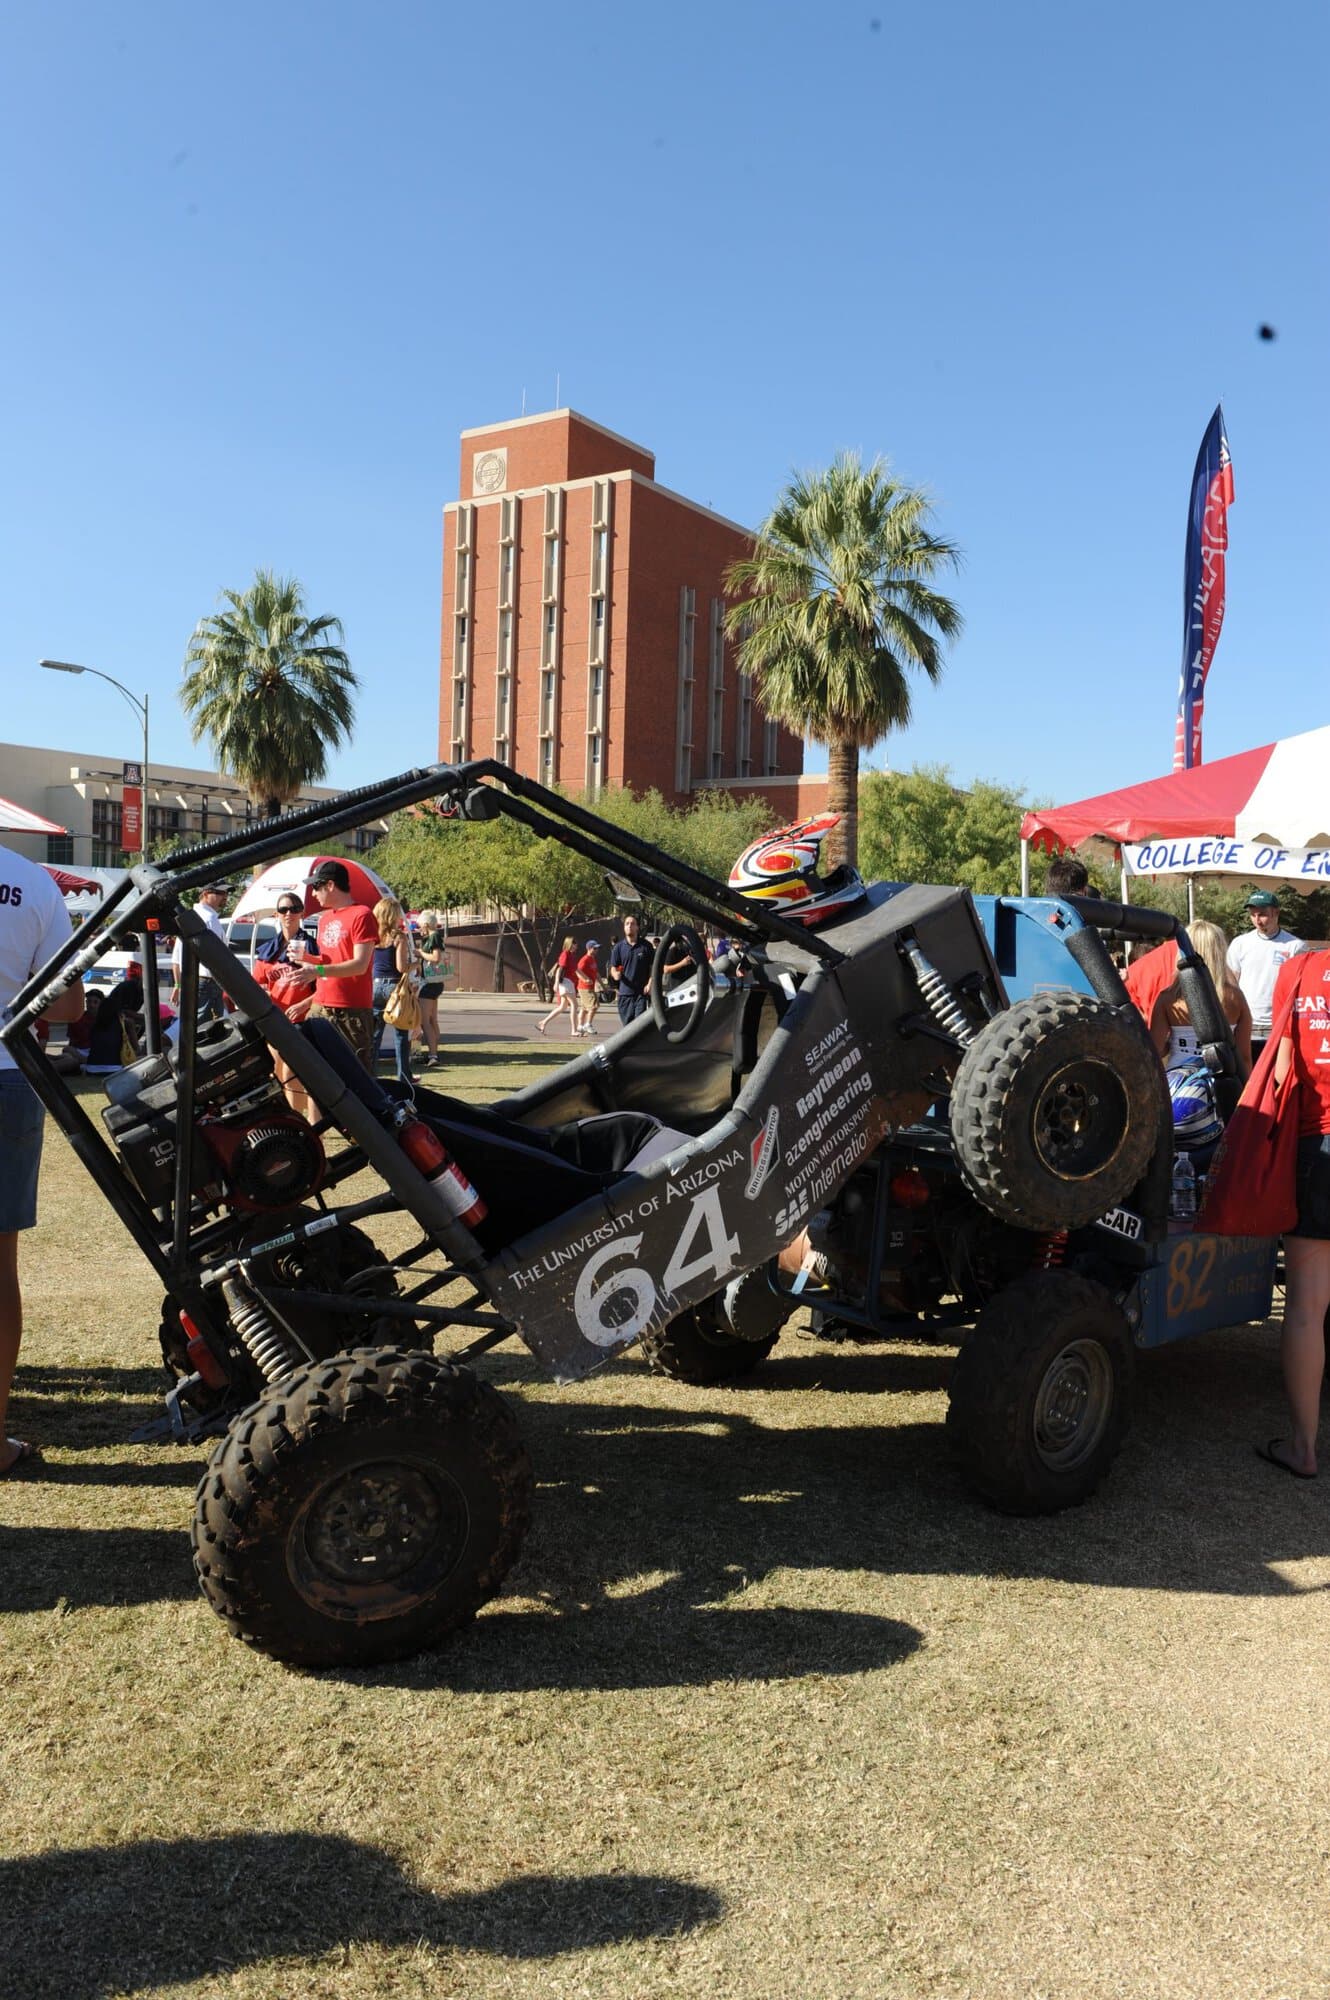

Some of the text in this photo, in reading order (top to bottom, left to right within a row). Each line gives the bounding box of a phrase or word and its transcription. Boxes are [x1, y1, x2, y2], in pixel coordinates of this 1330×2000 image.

[1137, 842, 1244, 870] COLLEGE
[1254, 848, 1289, 870] OF
[805, 1019, 849, 1066] SEAWAY
[796, 1047, 861, 1119] Raytheon
[149, 1139, 174, 1158] 10
[749, 1159, 767, 1194] BRIGGS
[764, 1110, 777, 1153] STRATTON
[785, 1072, 872, 1167] azengineering
[775, 1188, 809, 1236] SAE
[785, 1154, 820, 1198] MOTION
[508, 1150, 745, 1290] THE UNIVERSITY OF ARIZONA
[574, 1182, 741, 1347] 64
[1166, 1237, 1217, 1320] 82
